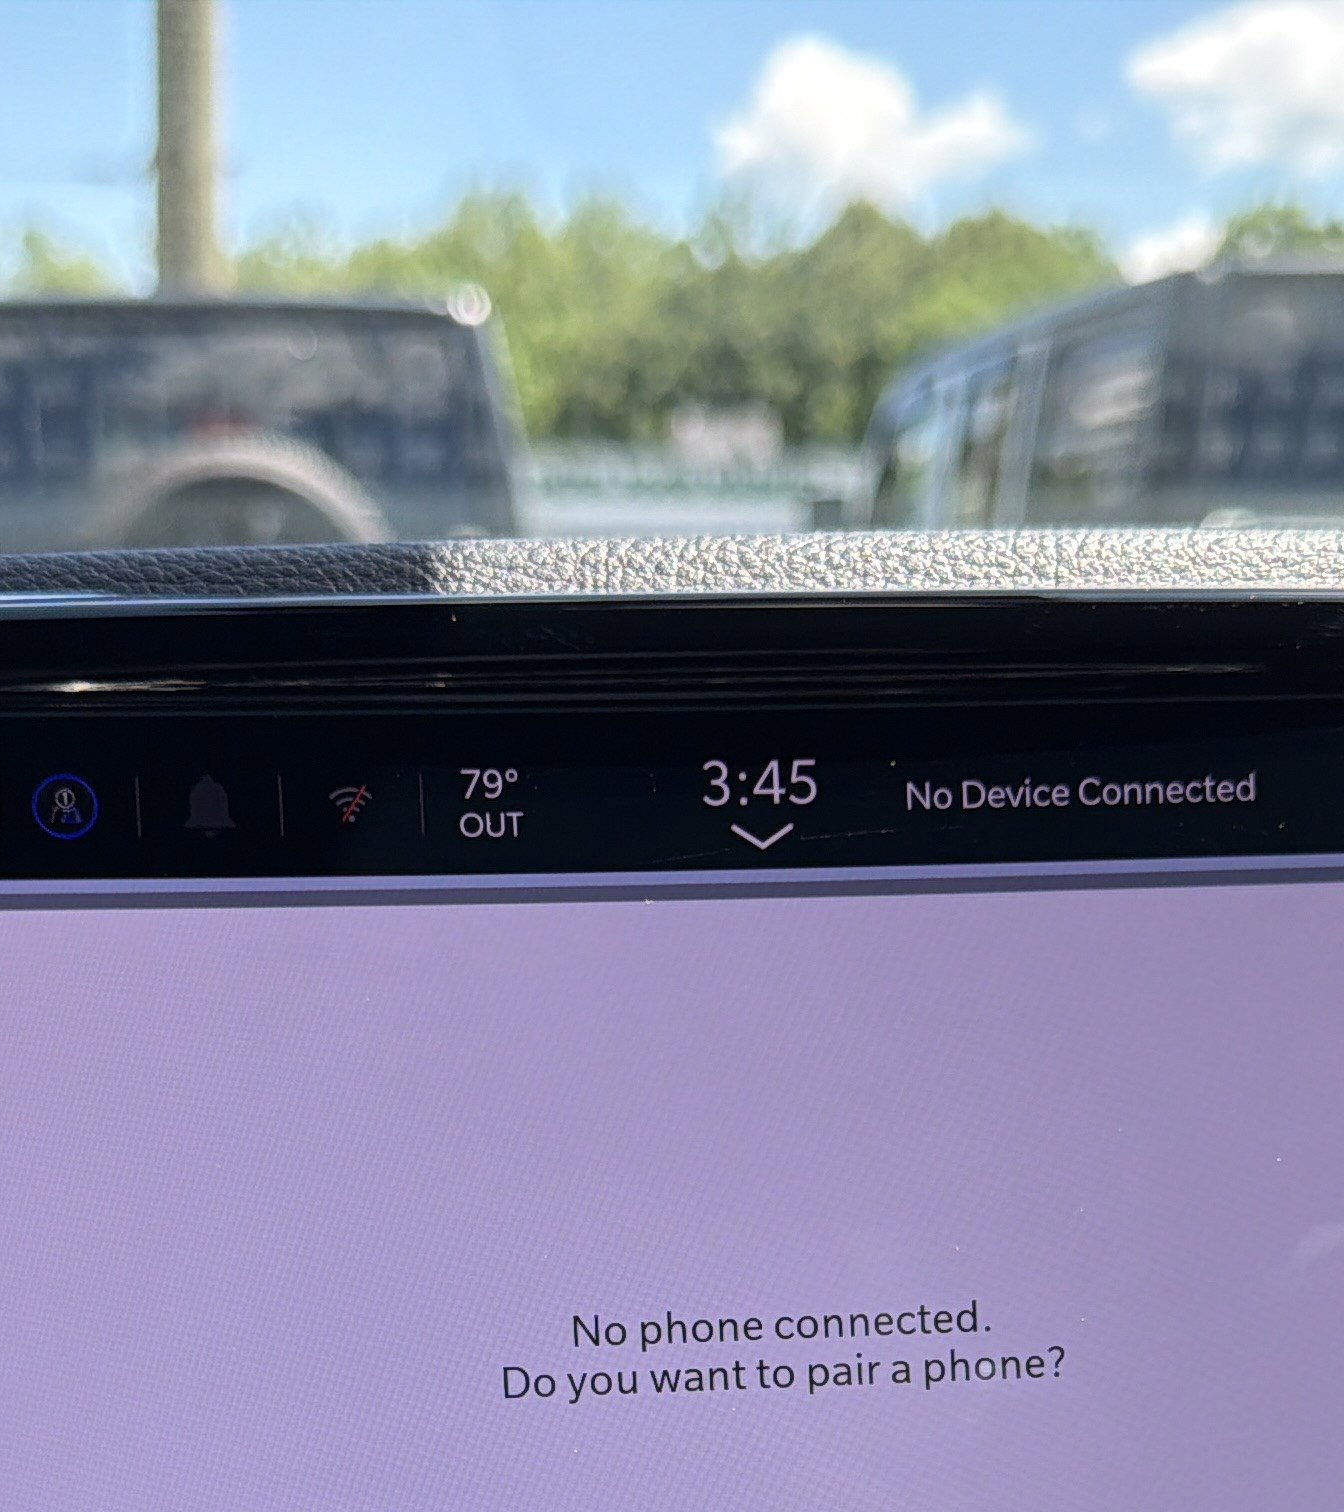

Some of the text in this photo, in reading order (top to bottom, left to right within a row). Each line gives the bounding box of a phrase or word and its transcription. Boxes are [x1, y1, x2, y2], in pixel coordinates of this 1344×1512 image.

[460, 768, 518, 800] 79°
[703, 759, 817, 807] 3:45
[906, 771, 1256, 811] No Device Connected
[459, 811, 524, 838] OUT
[572, 1299, 992, 1351] No phone connected.
[502, 1344, 1066, 1405] Do you want to pair a phone?
